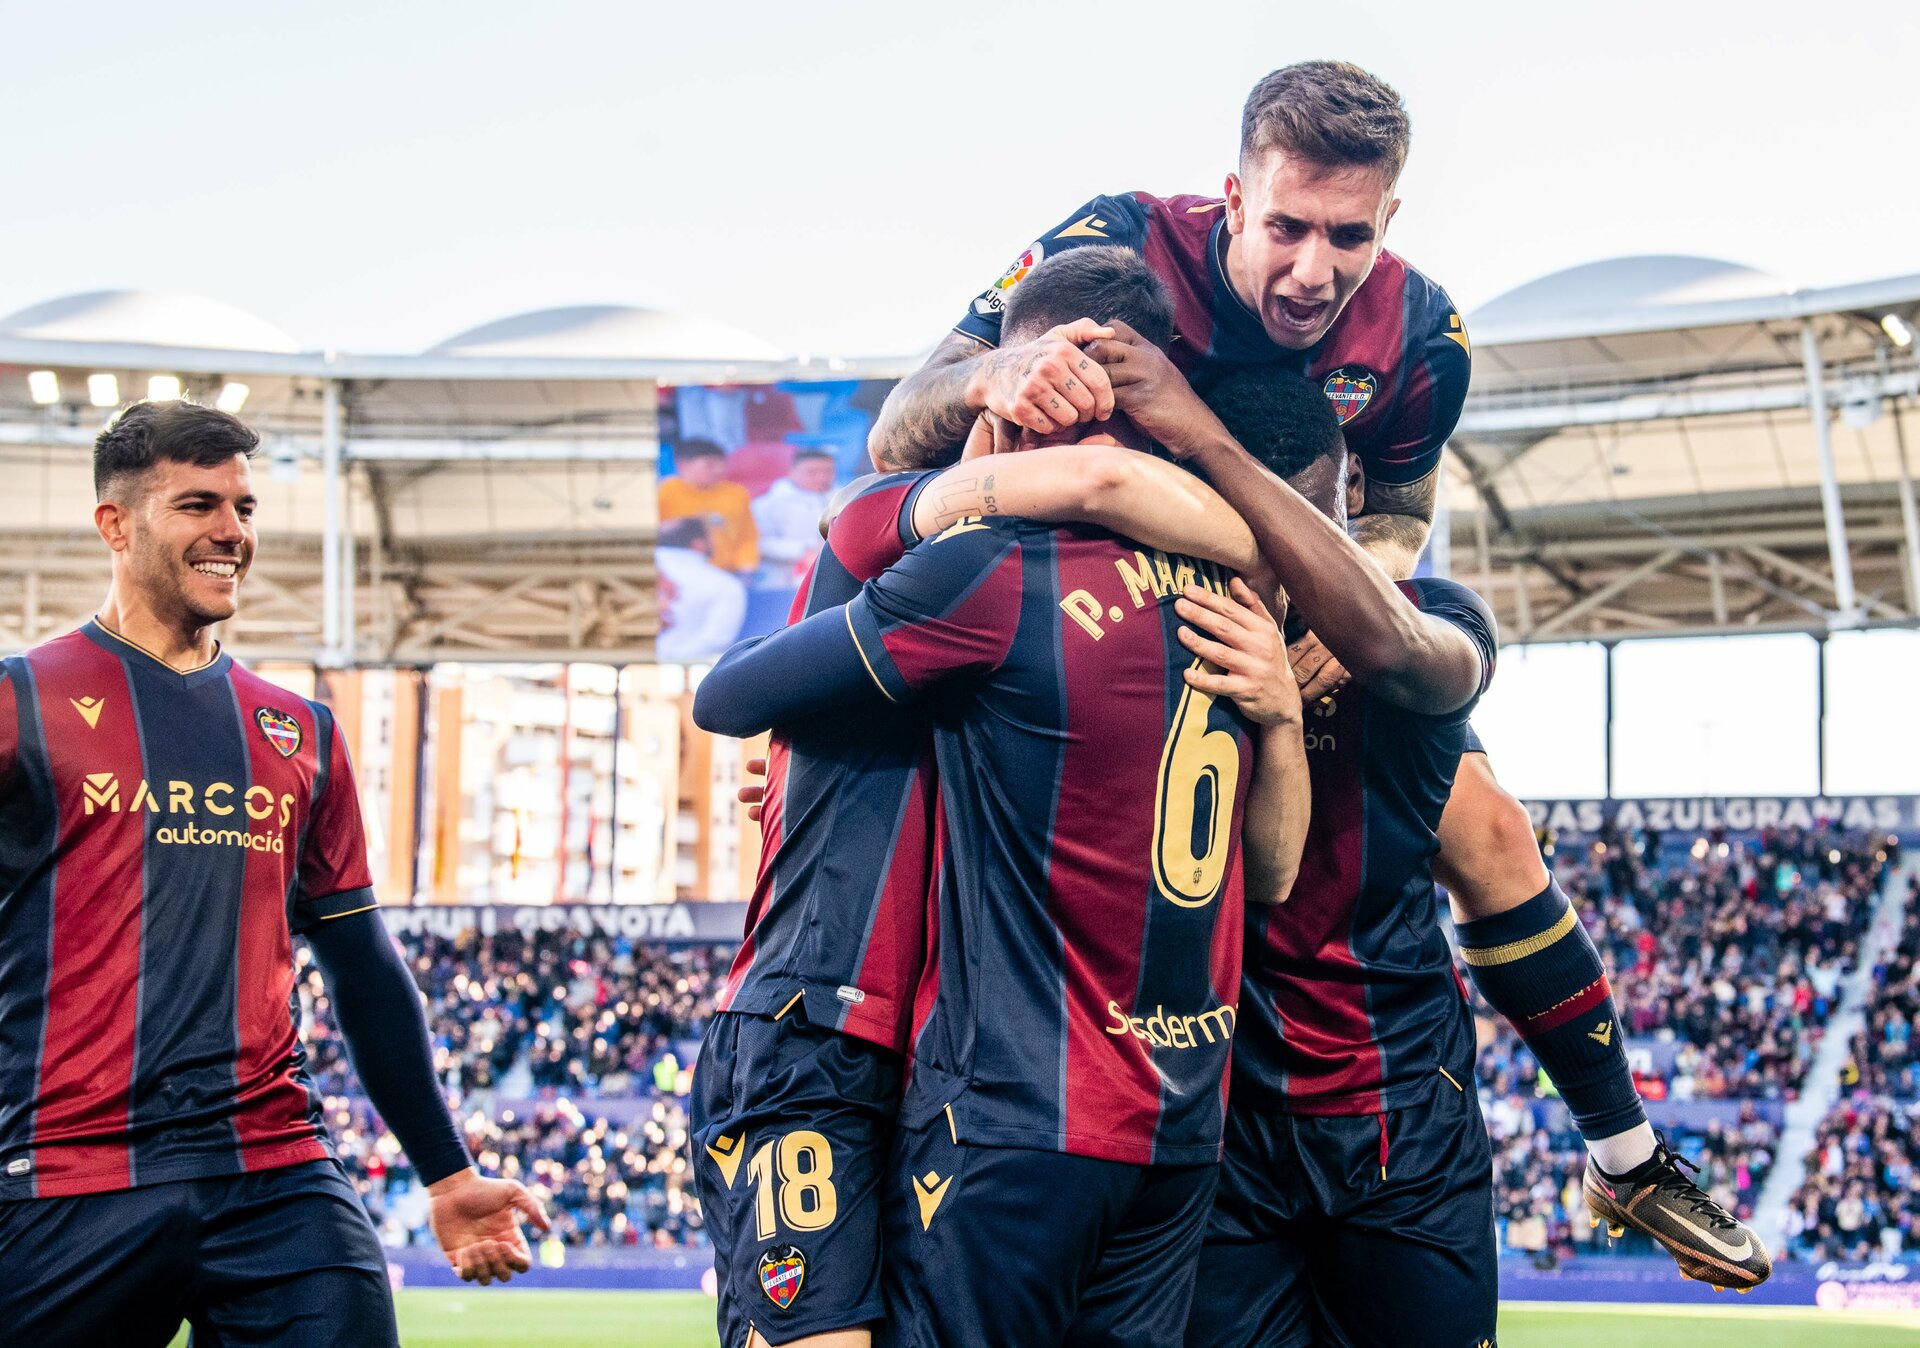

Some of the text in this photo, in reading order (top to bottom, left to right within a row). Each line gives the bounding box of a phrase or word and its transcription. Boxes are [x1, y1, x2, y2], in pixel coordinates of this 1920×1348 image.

[83, 772, 295, 828] MARCOS
[1151, 655, 1240, 908] 6
[747, 1130, 838, 1242] 18
